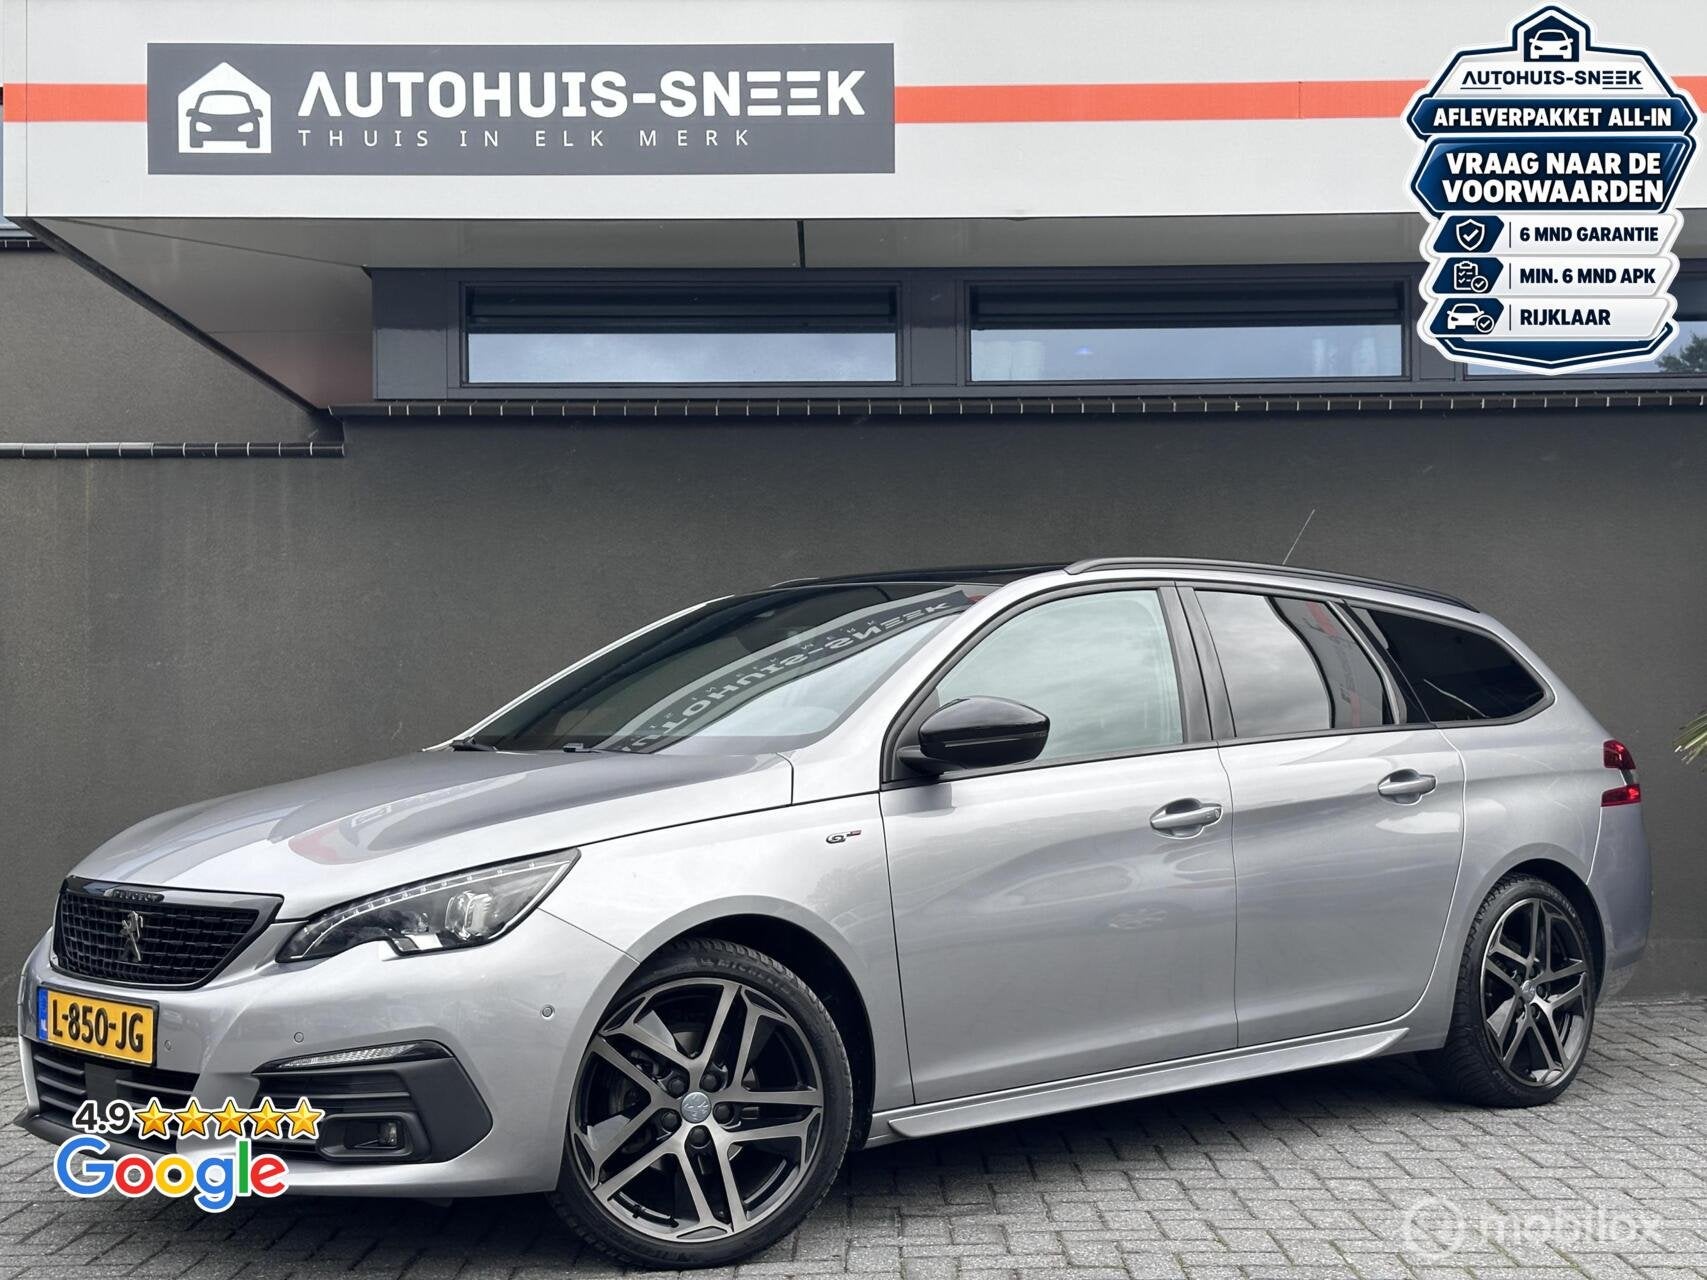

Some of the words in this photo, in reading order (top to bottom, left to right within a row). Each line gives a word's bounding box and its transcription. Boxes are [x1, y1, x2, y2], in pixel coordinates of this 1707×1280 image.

[298, 71, 865, 119] AUTOHUIS-SNEEK
[298, 129, 428, 147] THUIS
[460, 130, 498, 147] IN
[535, 129, 605, 147] ELK
[639, 129, 751, 147] MERK
[52, 999, 144, 1053] L-850-JG
